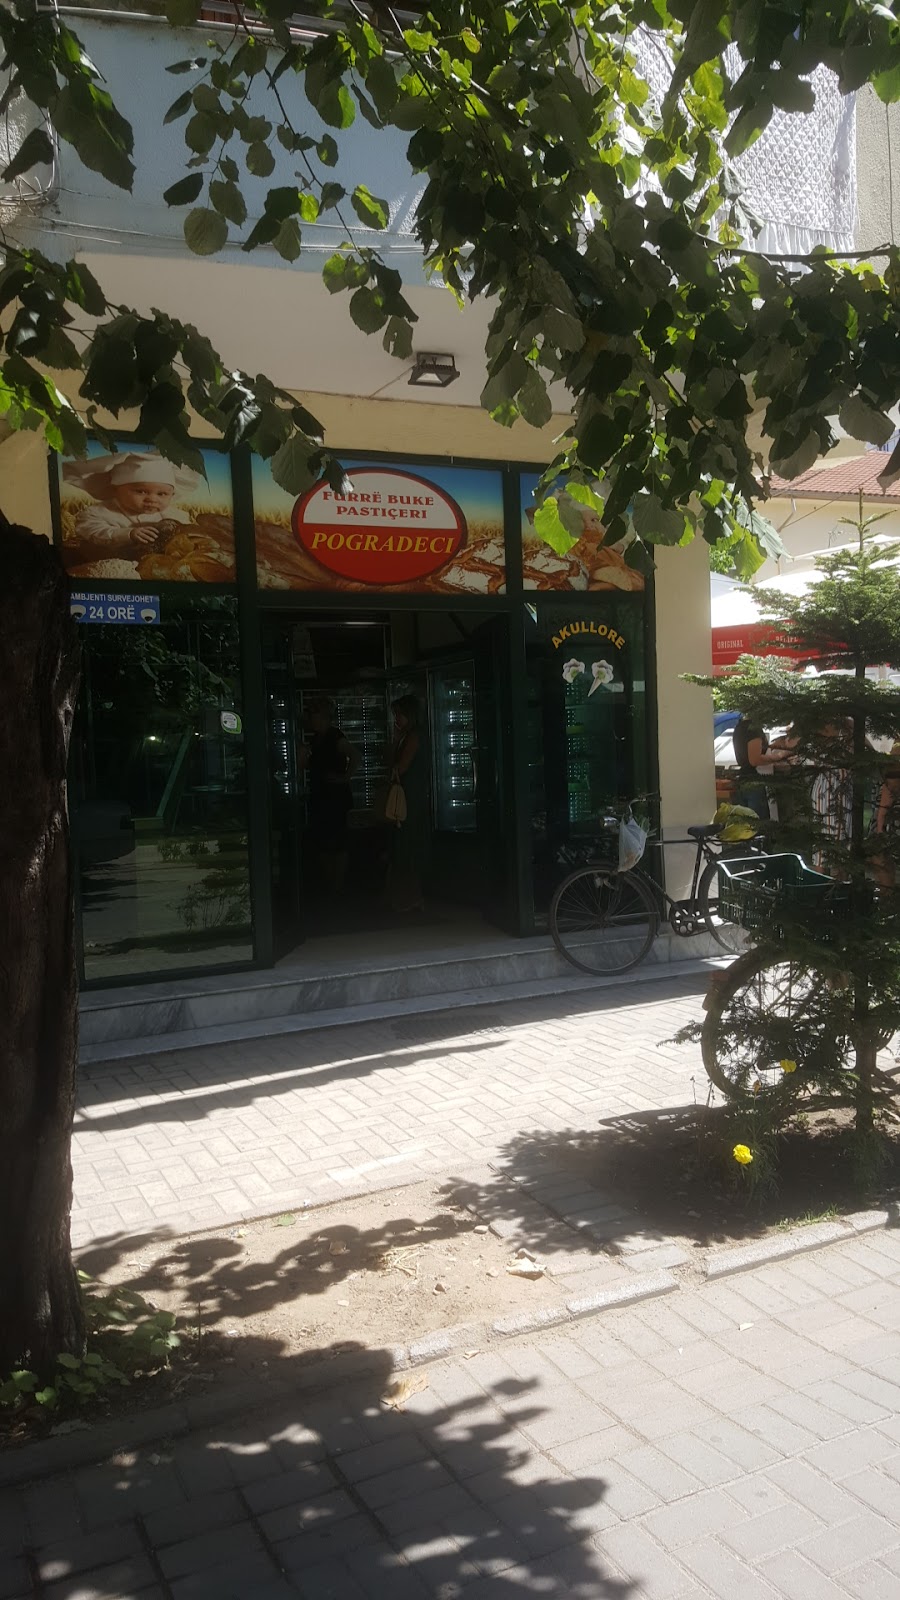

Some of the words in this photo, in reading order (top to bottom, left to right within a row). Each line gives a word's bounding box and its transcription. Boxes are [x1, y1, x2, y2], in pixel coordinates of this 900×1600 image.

[323, 491, 381, 503] FURRË
[388, 495, 434, 506] BUKE
[336, 506, 427, 520] PASTIÇERI
[310, 532, 456, 553] POGRADECI
[70, 593, 106, 601] AMBJENTI
[107, 594, 153, 602] SURVEJOHET
[89, 606, 104, 619] 24
[107, 605, 135, 620] ORË
[551, 621, 626, 650] AKULLORE
[716, 639, 744, 649] ORIGINAL
